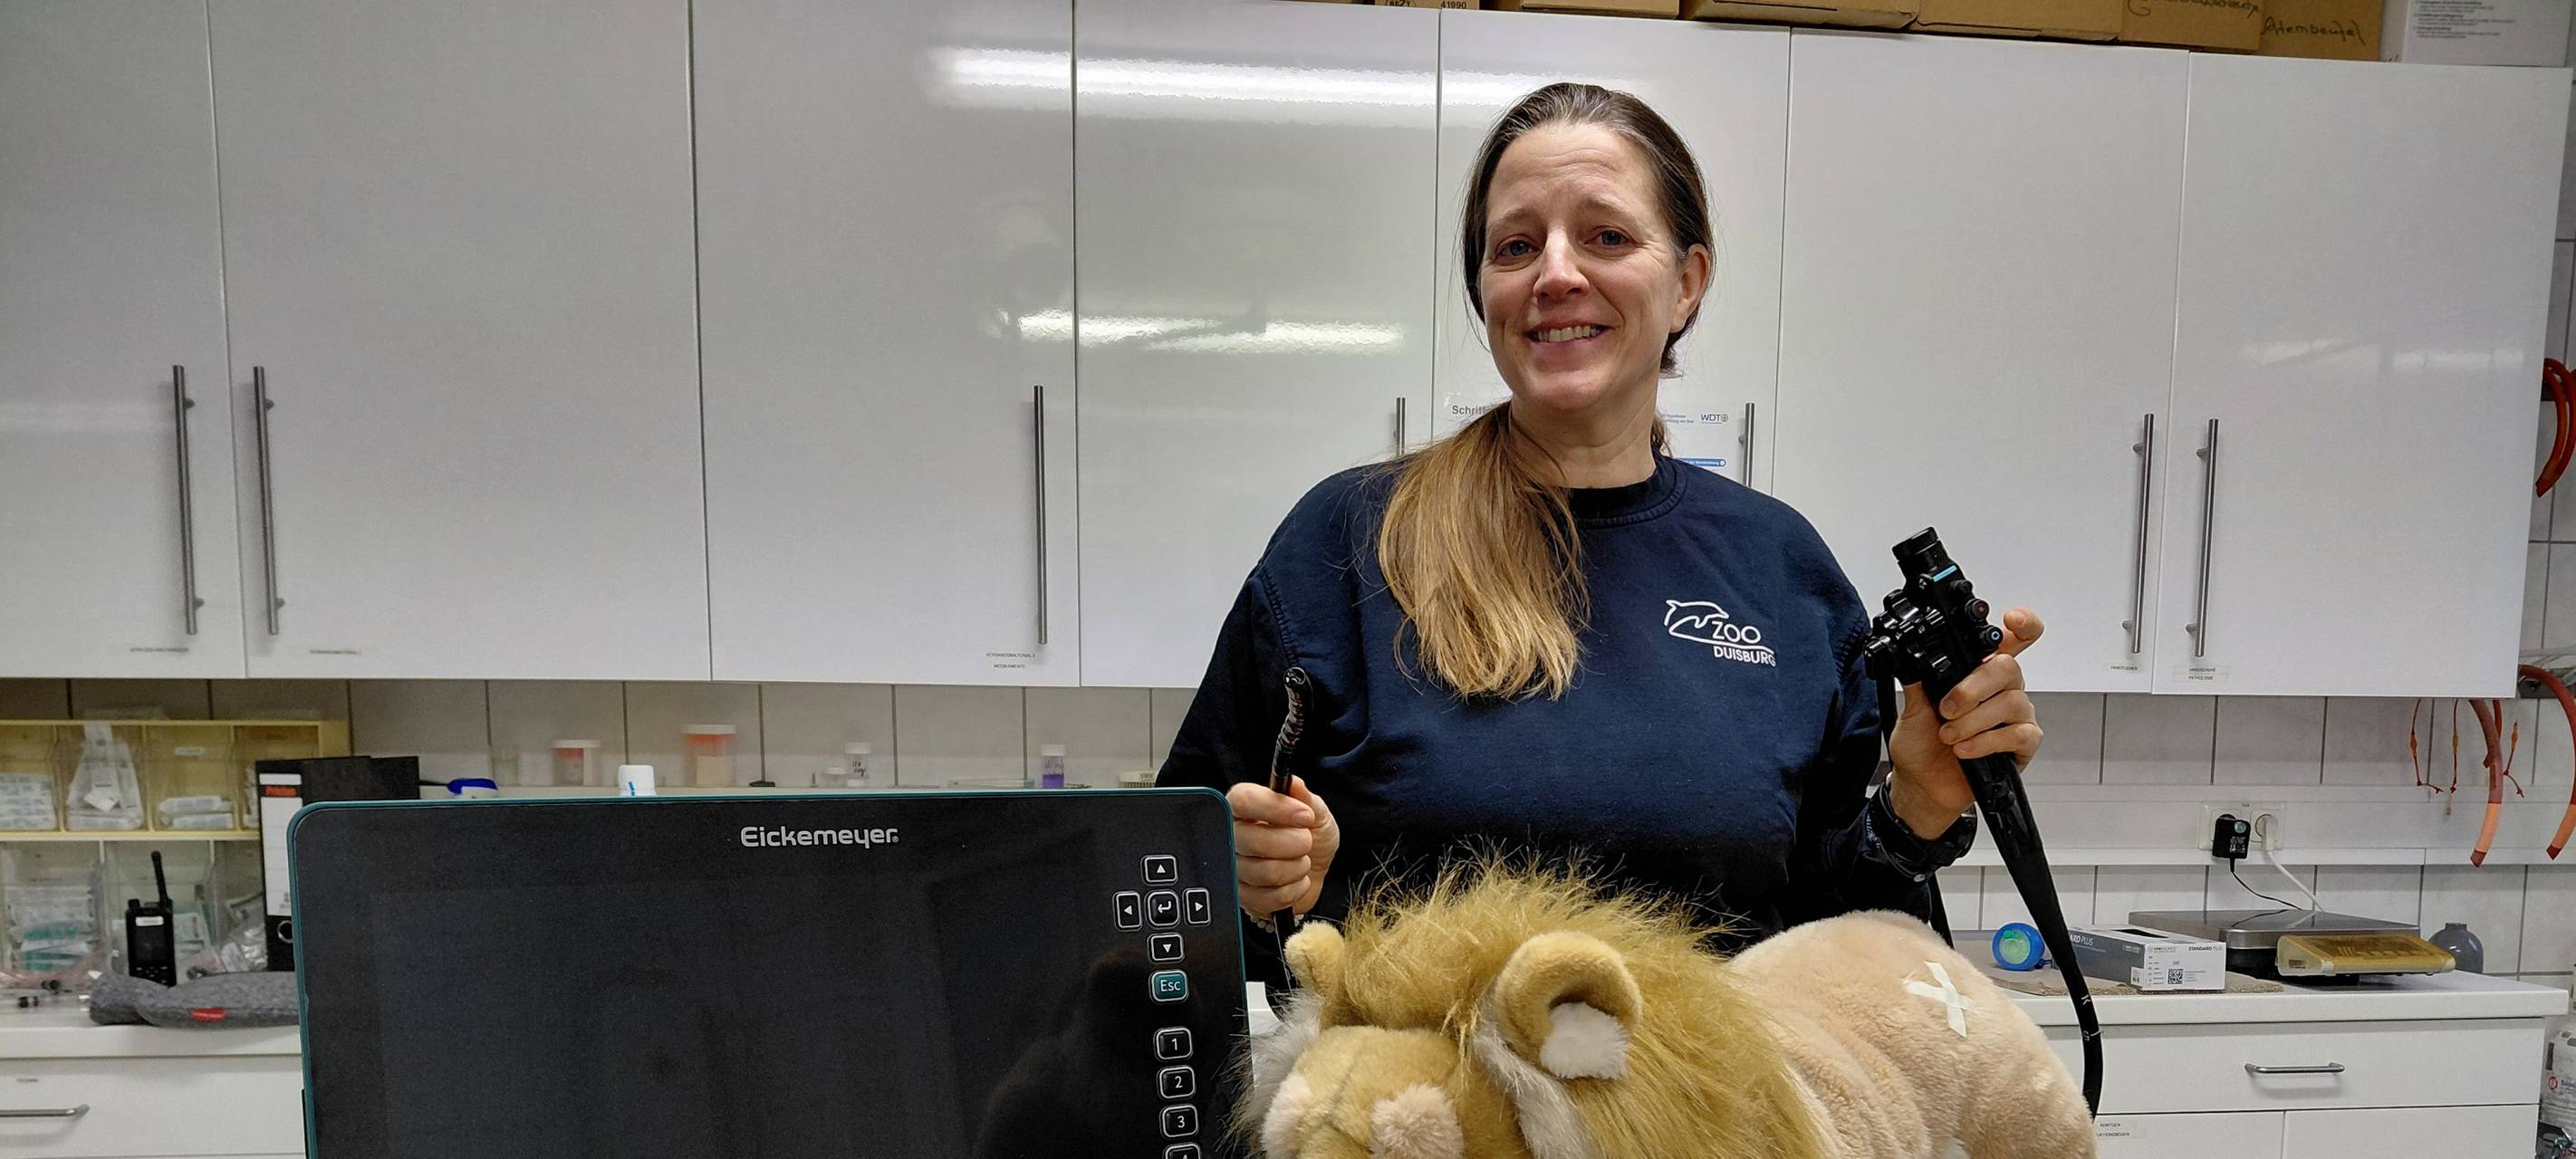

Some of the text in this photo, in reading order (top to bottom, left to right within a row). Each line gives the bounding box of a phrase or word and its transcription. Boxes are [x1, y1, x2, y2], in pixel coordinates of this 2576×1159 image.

[1701, 414, 1721, 422] WDT
[1711, 620, 1761, 644] ZOO
[1713, 646, 1776, 667] DUISBURG
[740, 825, 899, 849] Eickemeyer
[2081, 935, 2094, 946] PLUS
[1160, 979, 1181, 992] Esc
[1171, 1038, 1177, 1051] 1
[1174, 1076, 1183, 1088] 2
[1177, 1115, 1186, 1128] 3
